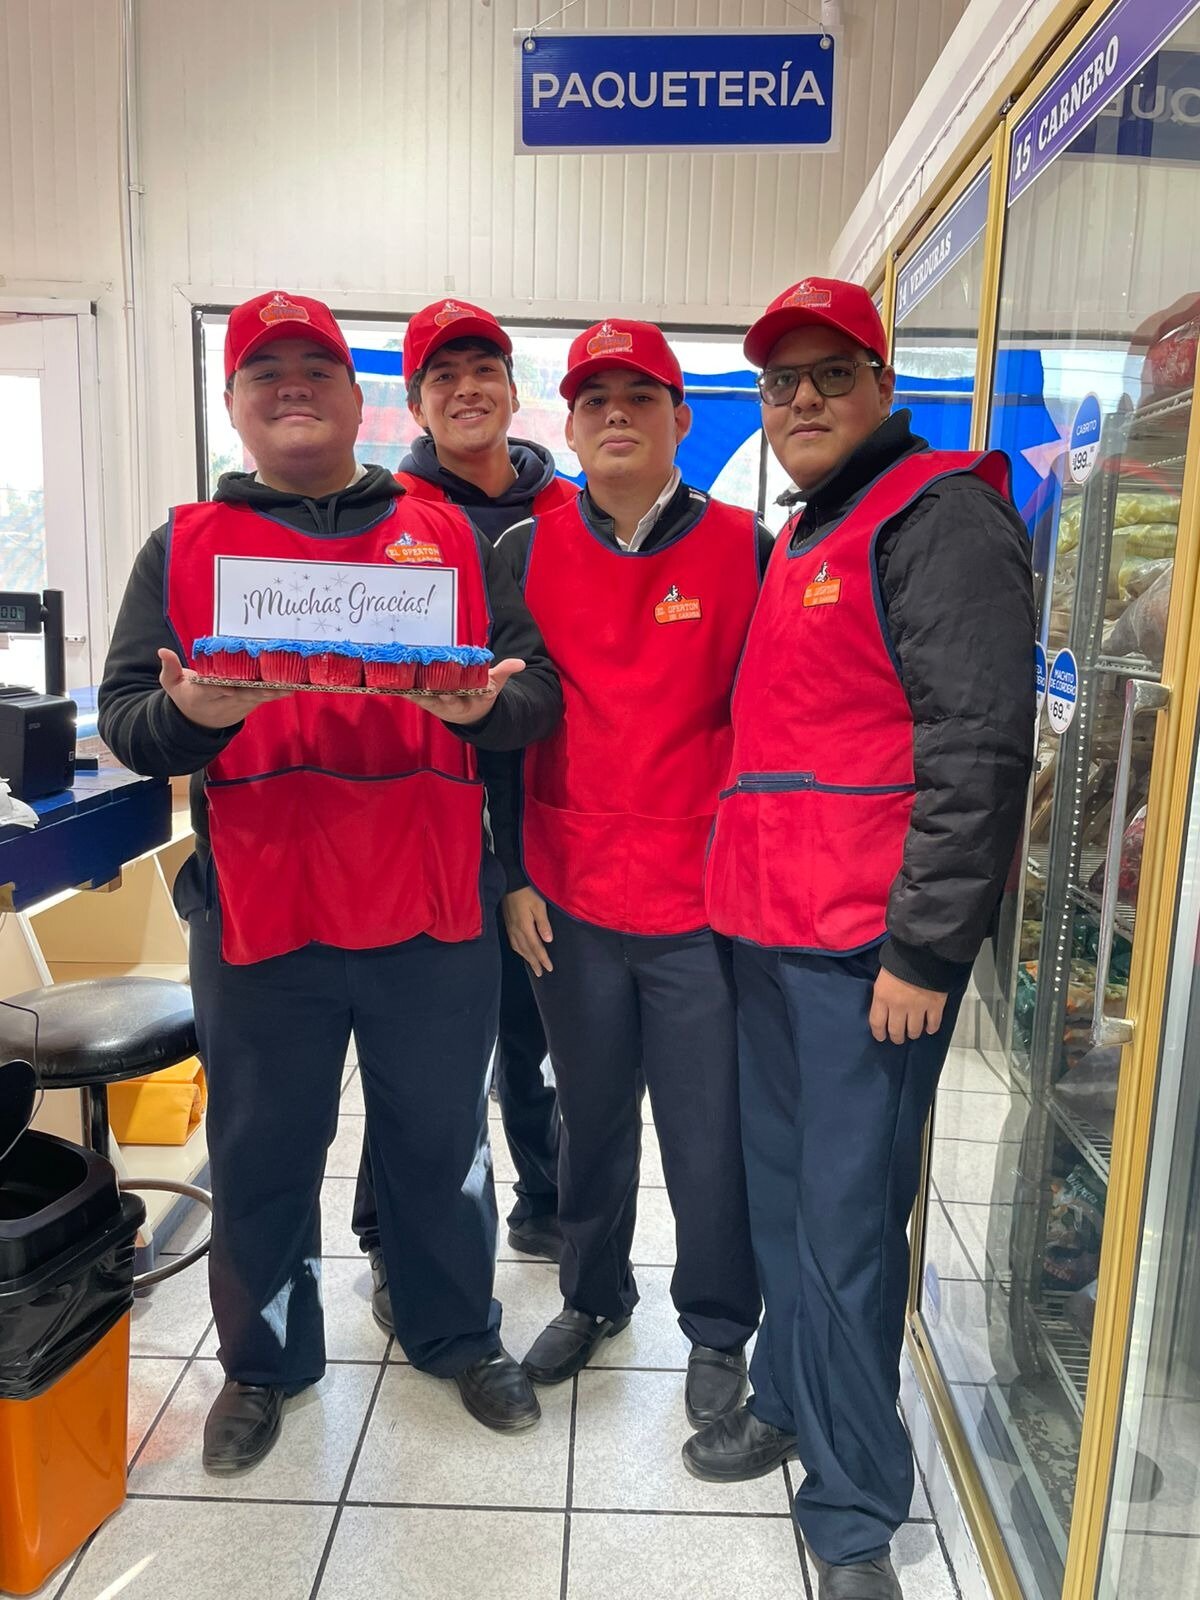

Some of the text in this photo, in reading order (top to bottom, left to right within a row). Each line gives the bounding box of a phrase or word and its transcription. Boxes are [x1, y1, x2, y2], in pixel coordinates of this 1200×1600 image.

[532, 61, 825, 109] PAQUETERÍA
[1014, 35, 1119, 181] 15 CARNERO
[910, 230, 952, 295] VERDURAS
[1076, 419, 1097, 436] CABRITO
[243, 582, 436, 625] ¡Muchas Gracias!
[1054, 668, 1075, 684] MACHITO
[1056, 679, 1076, 696] CORDERO
